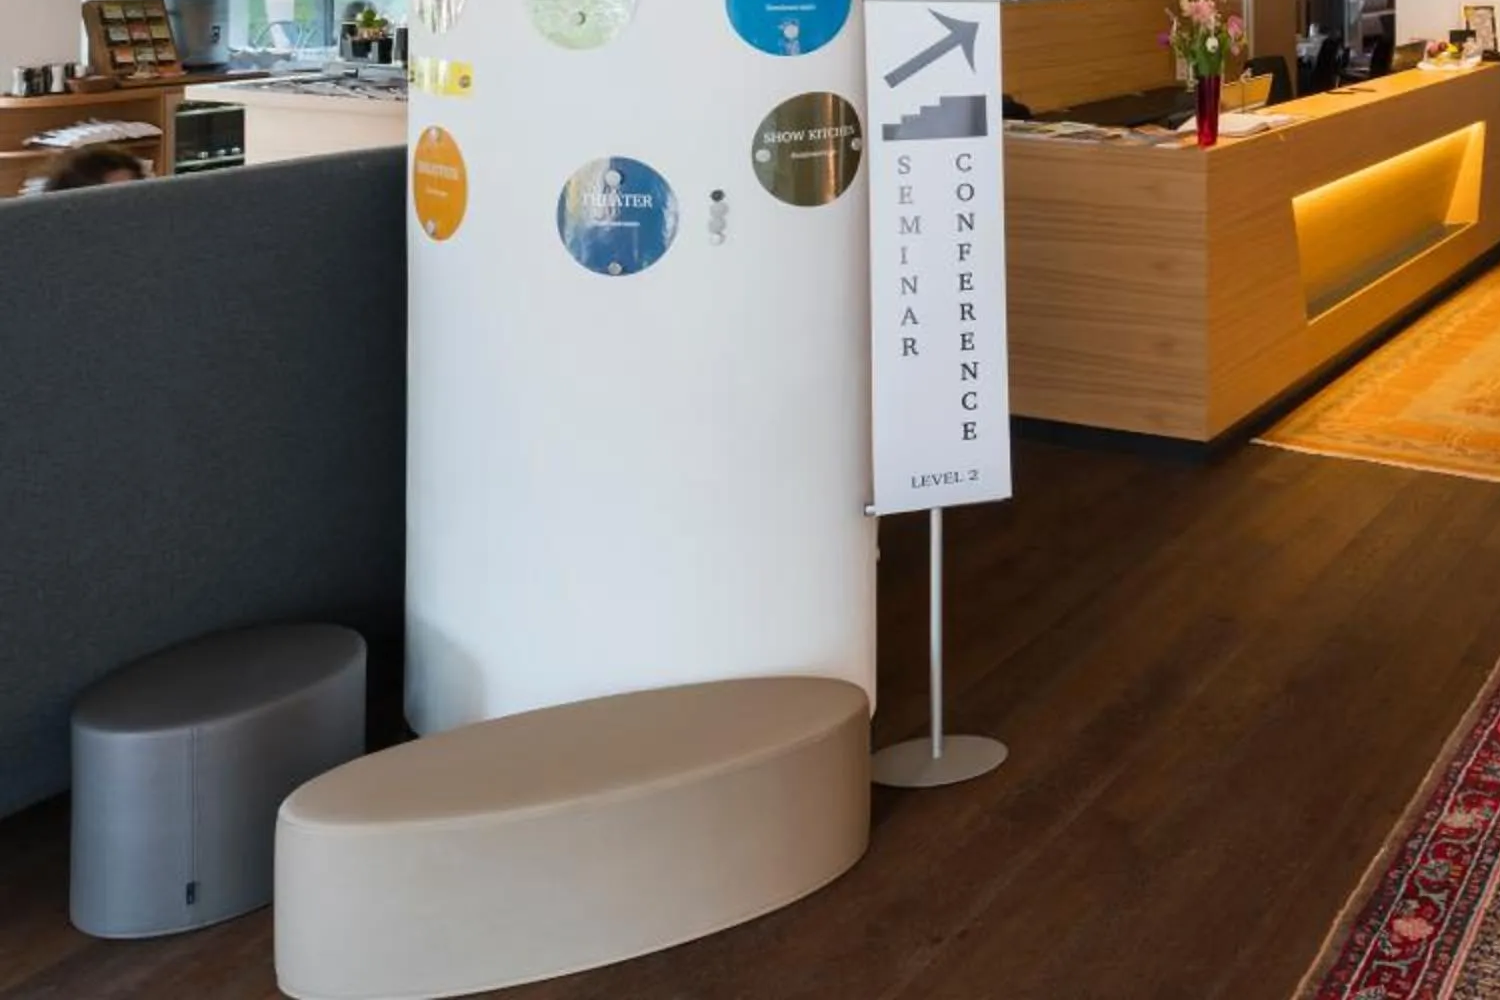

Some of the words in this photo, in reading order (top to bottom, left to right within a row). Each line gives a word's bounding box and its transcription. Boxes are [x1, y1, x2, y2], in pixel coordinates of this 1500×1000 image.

[763, 130, 805, 144] SHOW
[582, 192, 653, 209] THEATER
[897, 155, 921, 357] SEMINAR
[955, 153, 979, 441] CONFERENCE
[911, 471, 964, 489] LEVEL
[967, 468, 979, 481] 2
